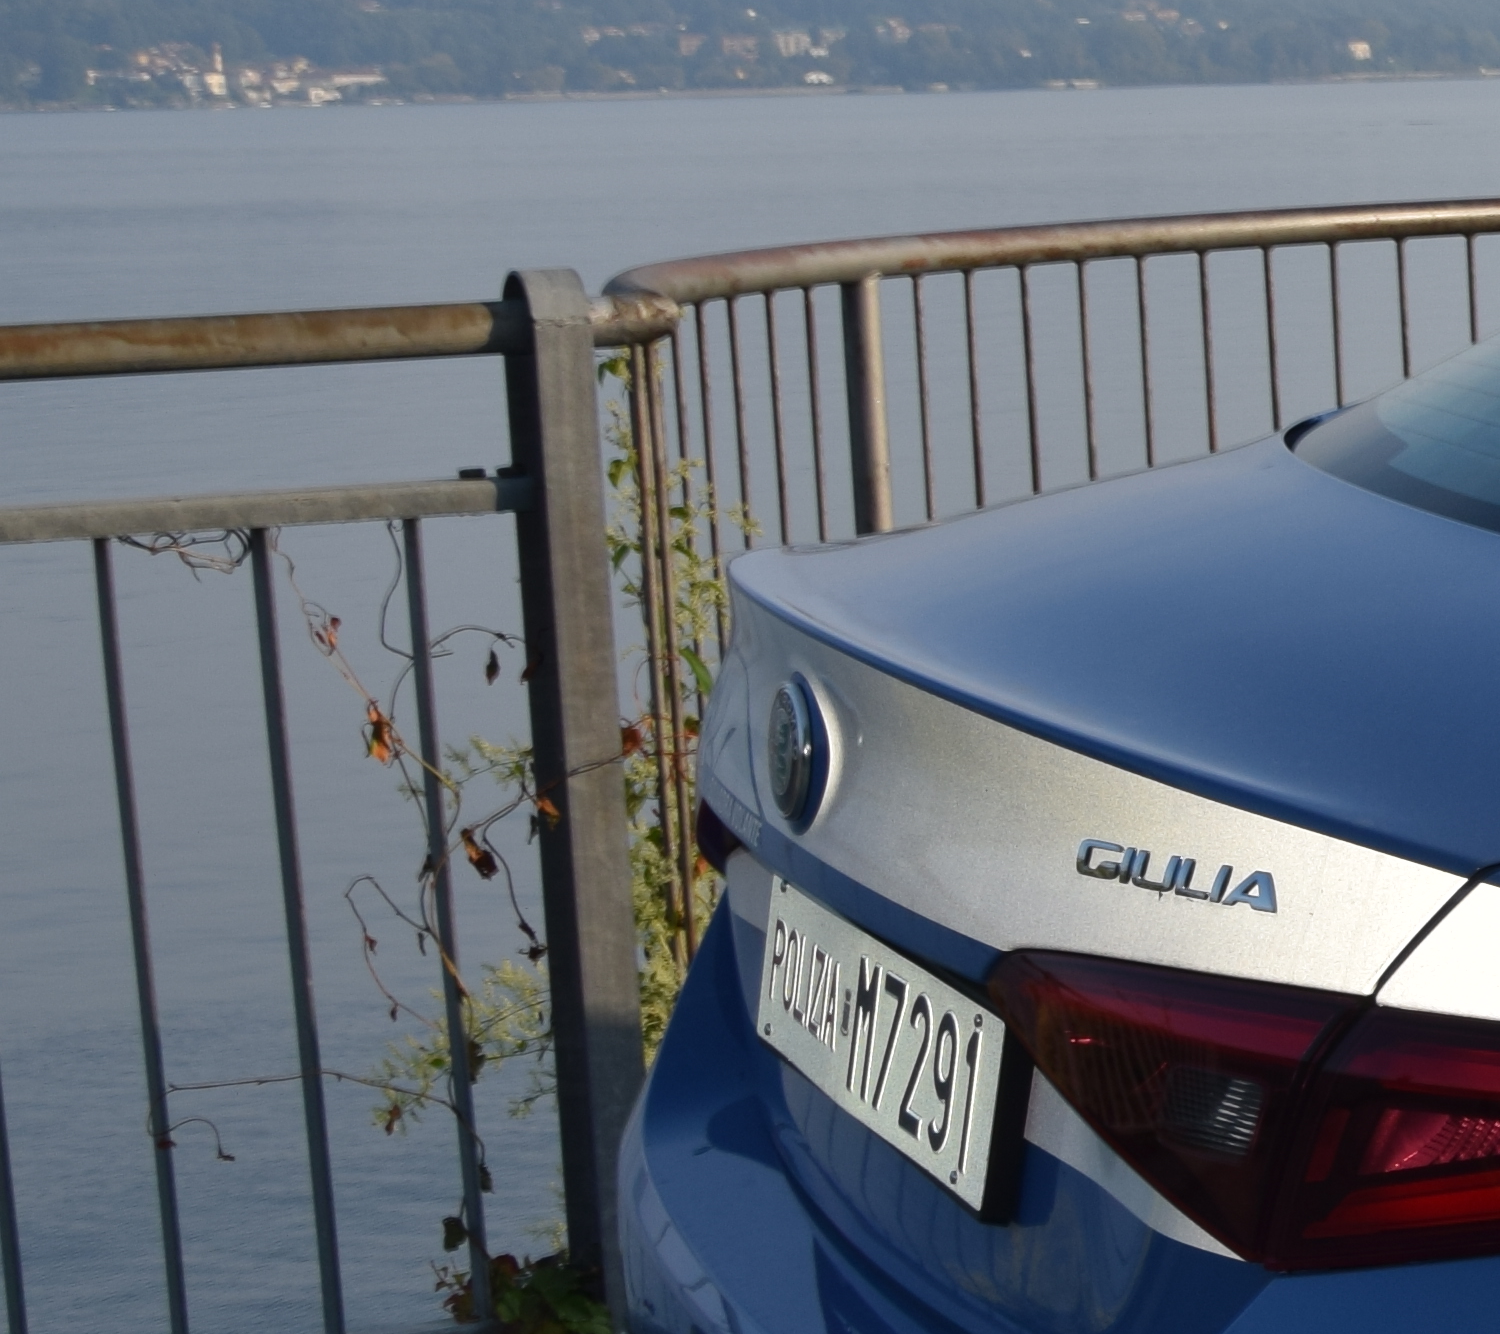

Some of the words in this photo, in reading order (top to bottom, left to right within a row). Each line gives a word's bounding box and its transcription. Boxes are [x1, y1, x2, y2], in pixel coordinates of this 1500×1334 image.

[1076, 838, 1277, 913] GIULIA
[770, 919, 840, 1053] POLIZIA
[845, 954, 982, 1176] M7291
